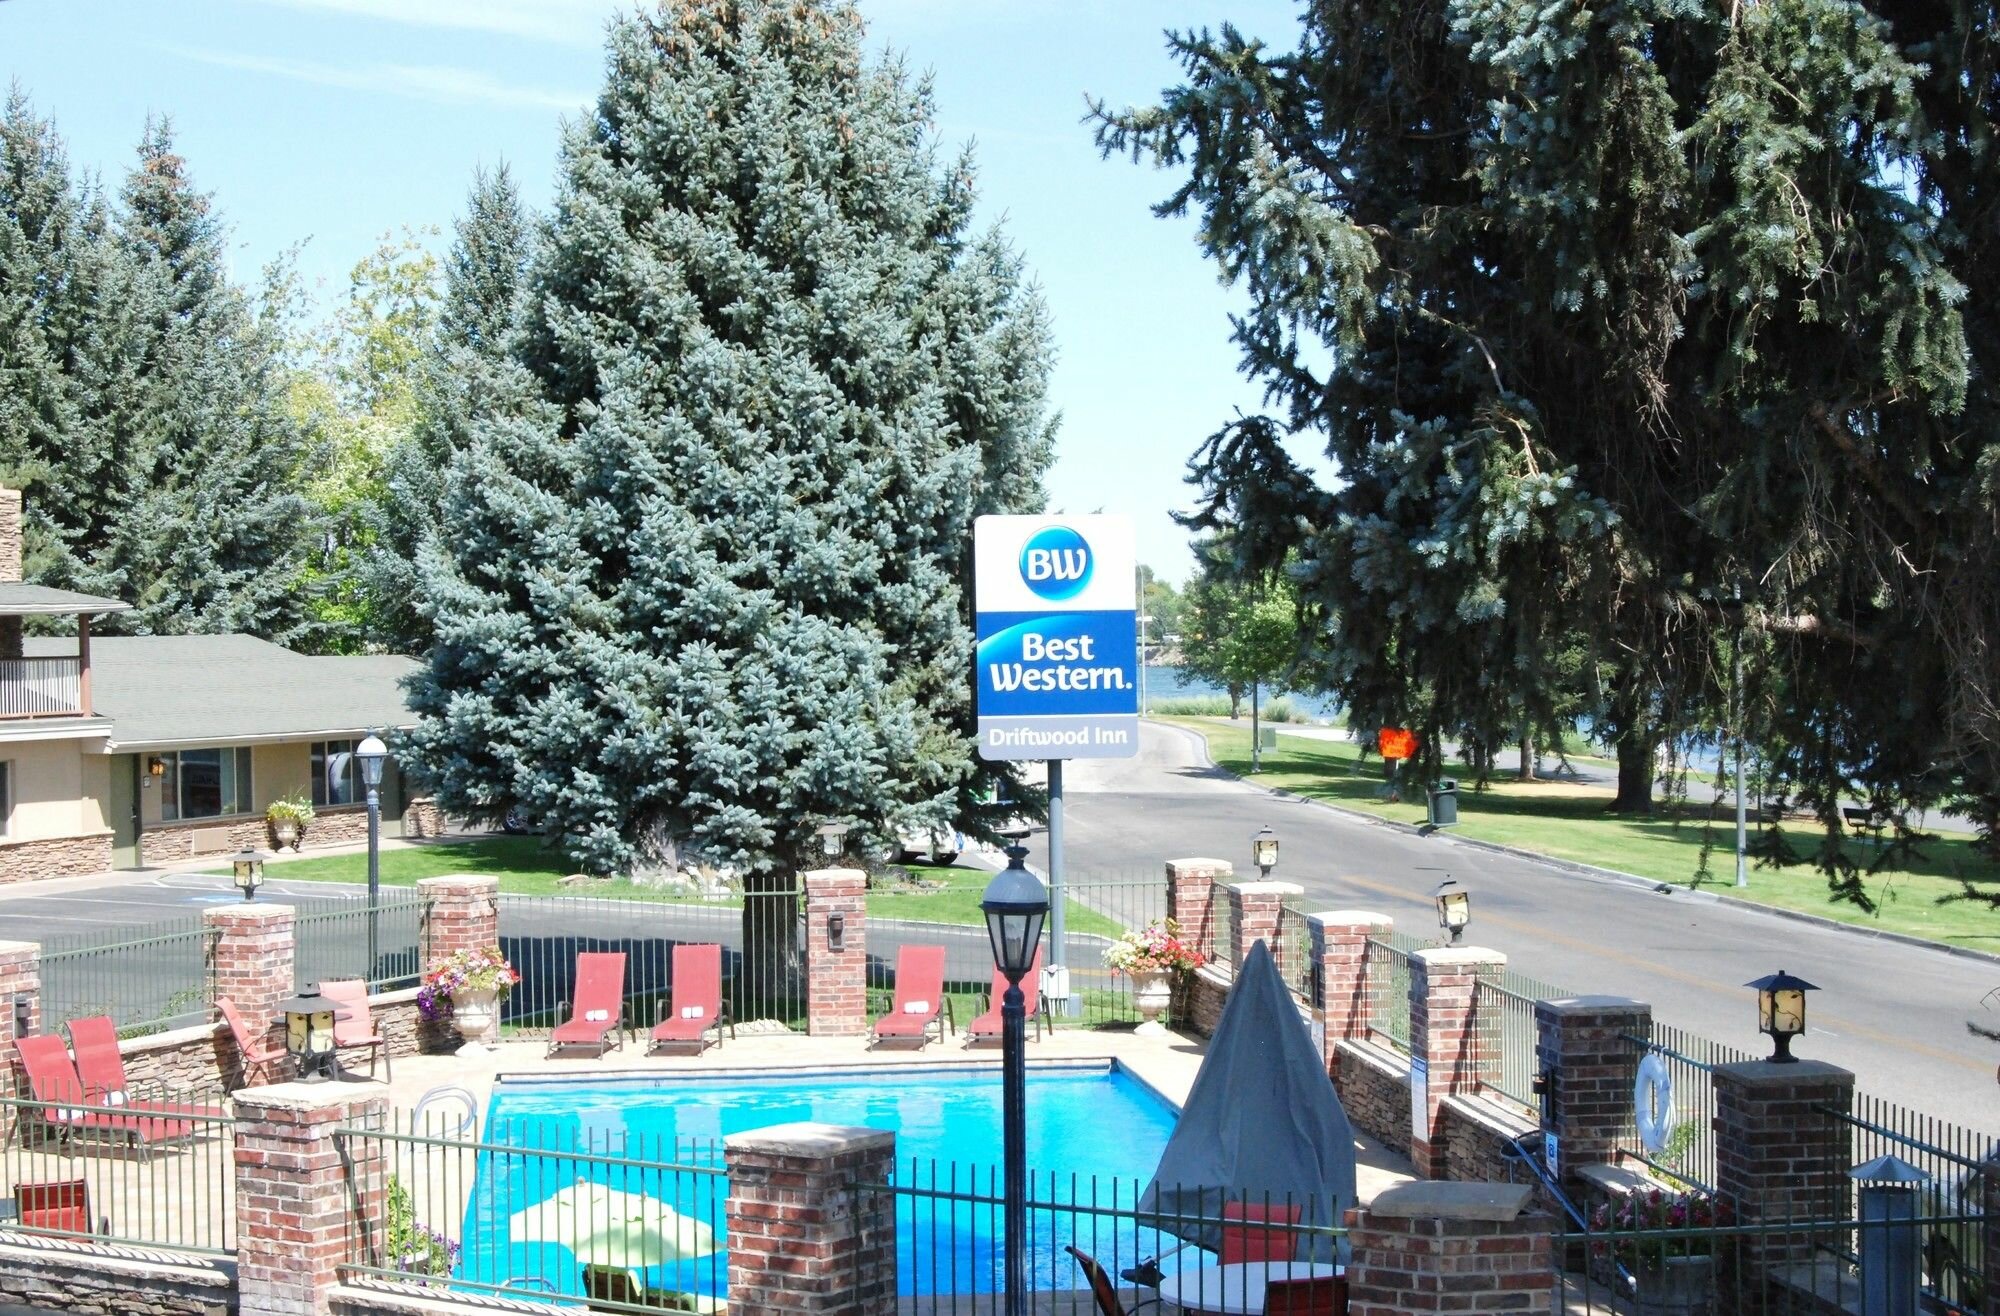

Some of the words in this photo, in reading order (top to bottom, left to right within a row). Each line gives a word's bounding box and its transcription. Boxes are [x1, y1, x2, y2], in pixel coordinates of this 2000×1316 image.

[1027, 549, 1087, 581] BW
[1022, 632, 1095, 662] Best
[990, 663, 1133, 692] Western.
[989, 726, 1089, 746] Driftwood
[1095, 726, 1128, 745] Inn
